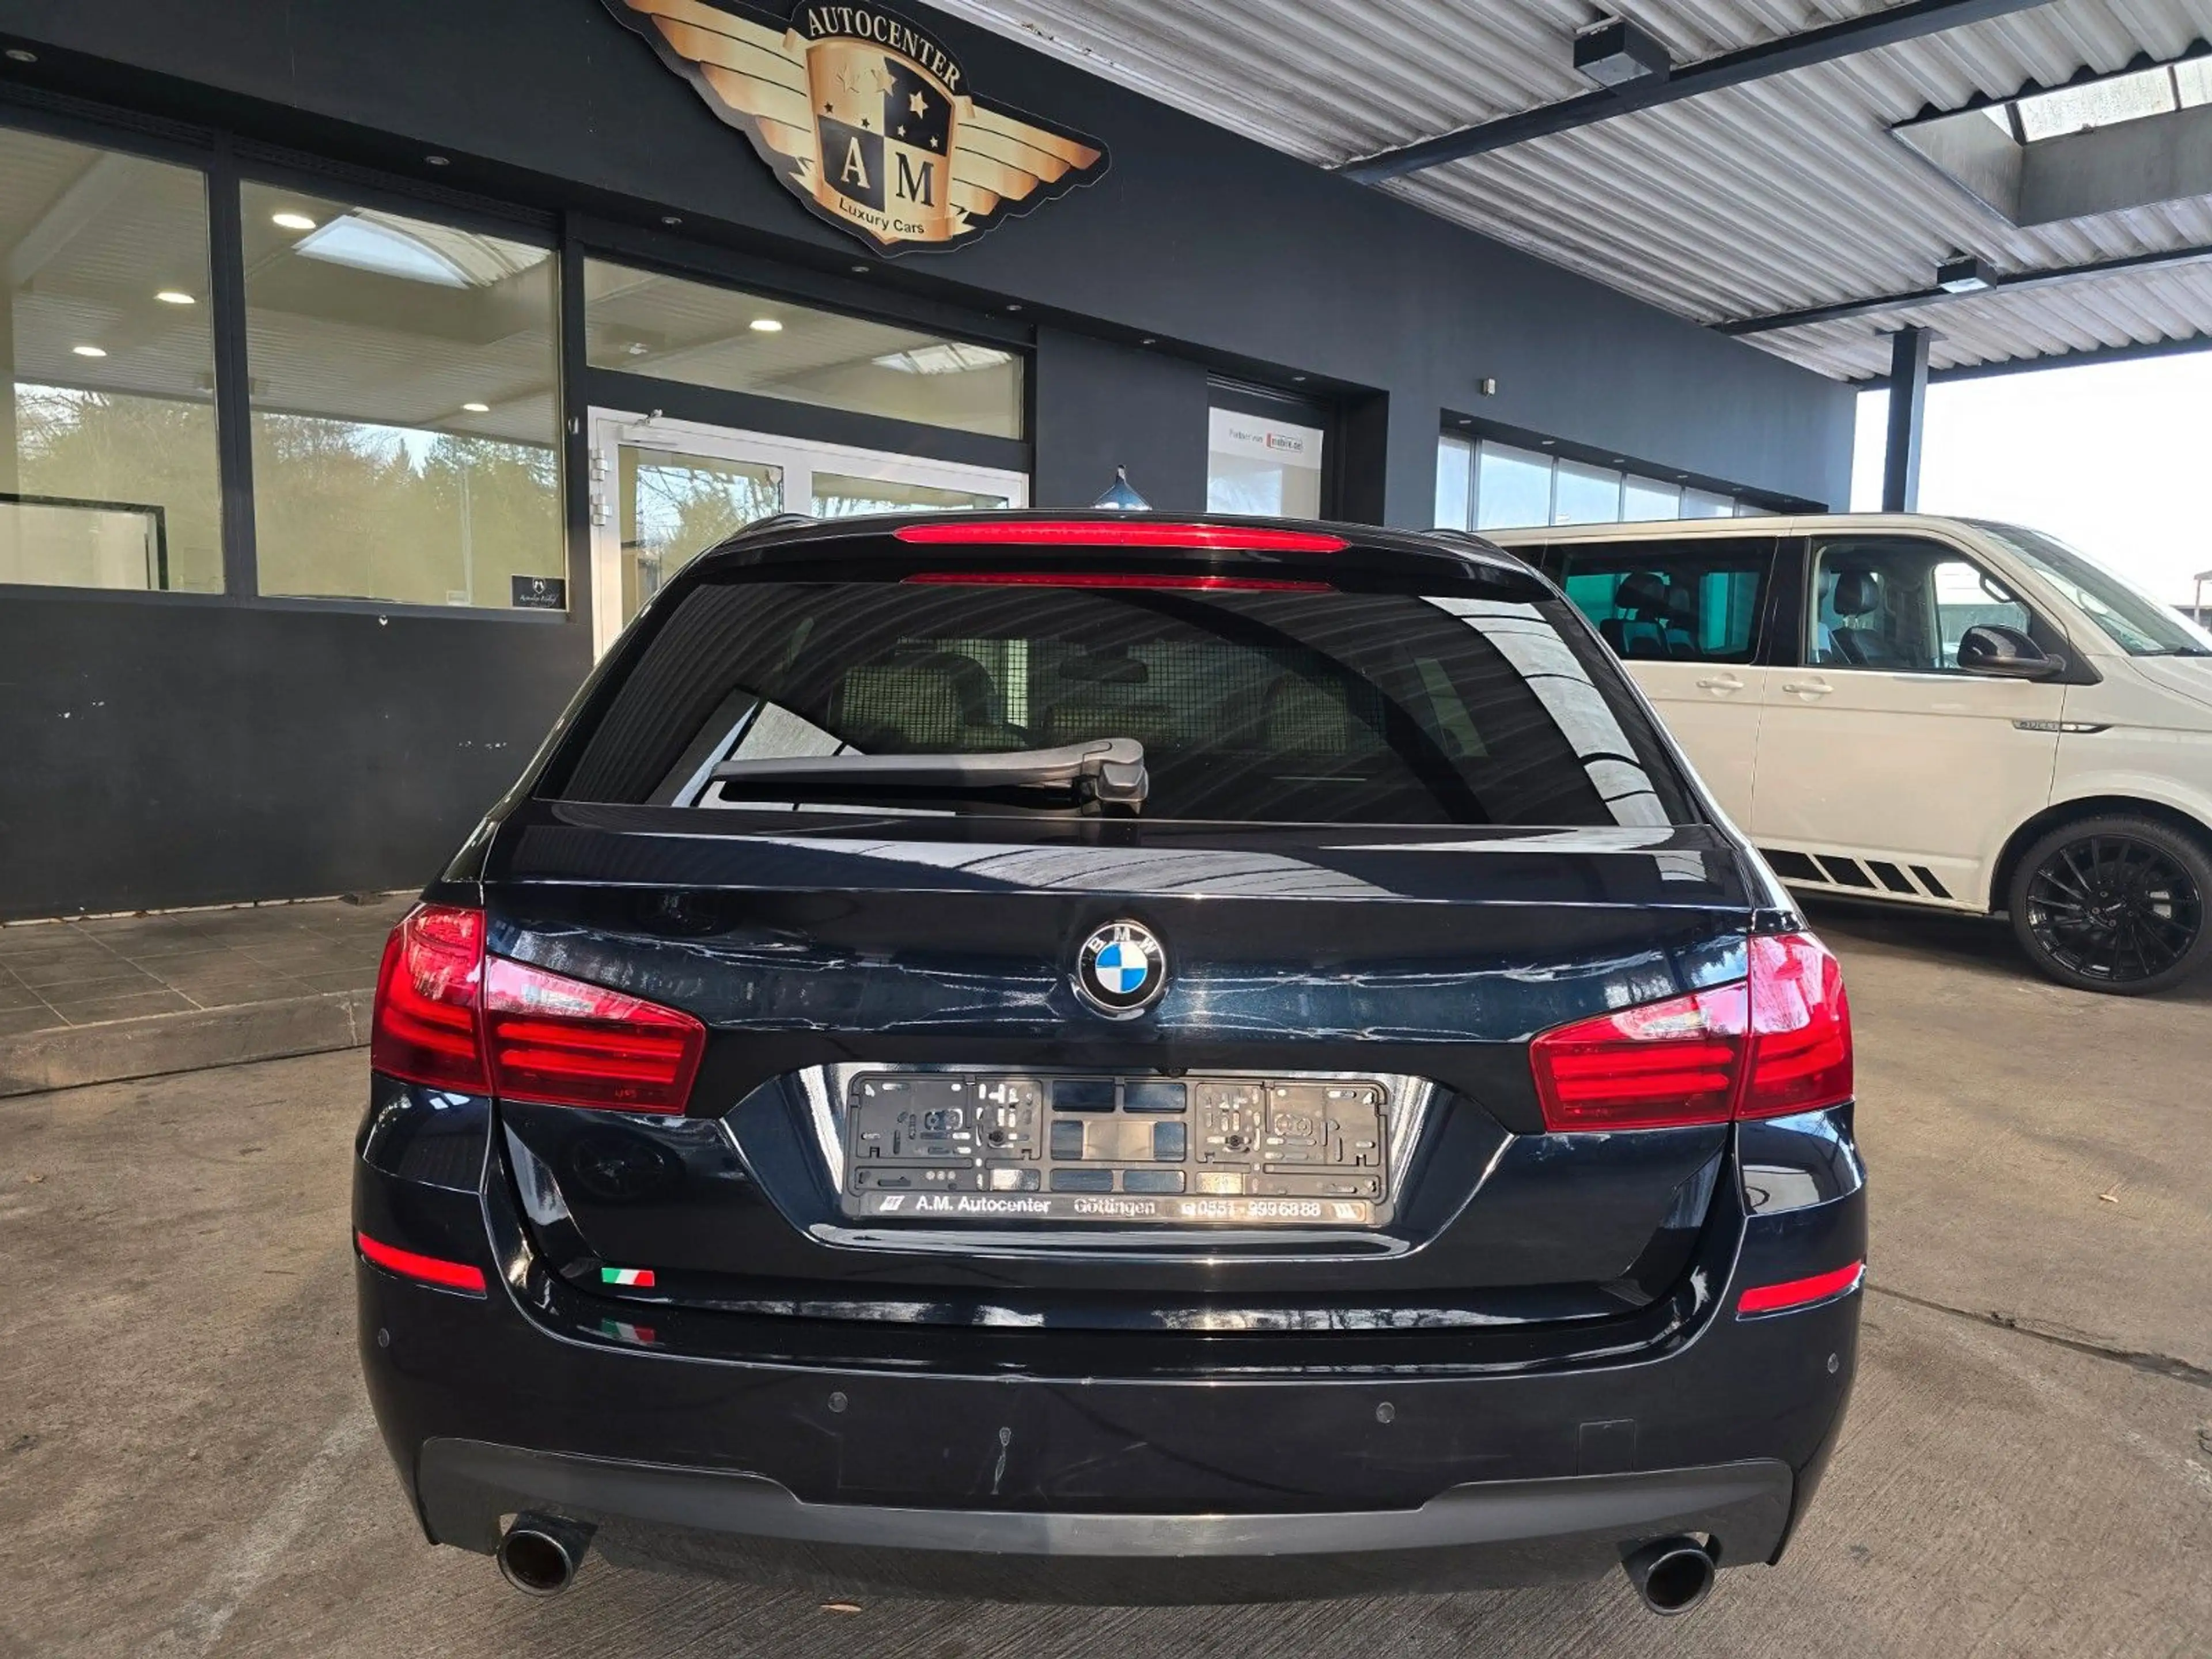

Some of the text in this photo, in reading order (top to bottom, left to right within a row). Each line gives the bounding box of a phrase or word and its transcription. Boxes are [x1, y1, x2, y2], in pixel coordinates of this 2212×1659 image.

[808, 6, 961, 90] AUTOCENTER
[840, 137, 934, 207] A M
[839, 197, 925, 234] Luxury Cars
[1087, 926, 1158, 955] BMW
[915, 1195, 953, 1211] A.M.
[958, 1196, 1051, 1213] Autocenter
[1074, 1198, 1155, 1217] Göttingen
